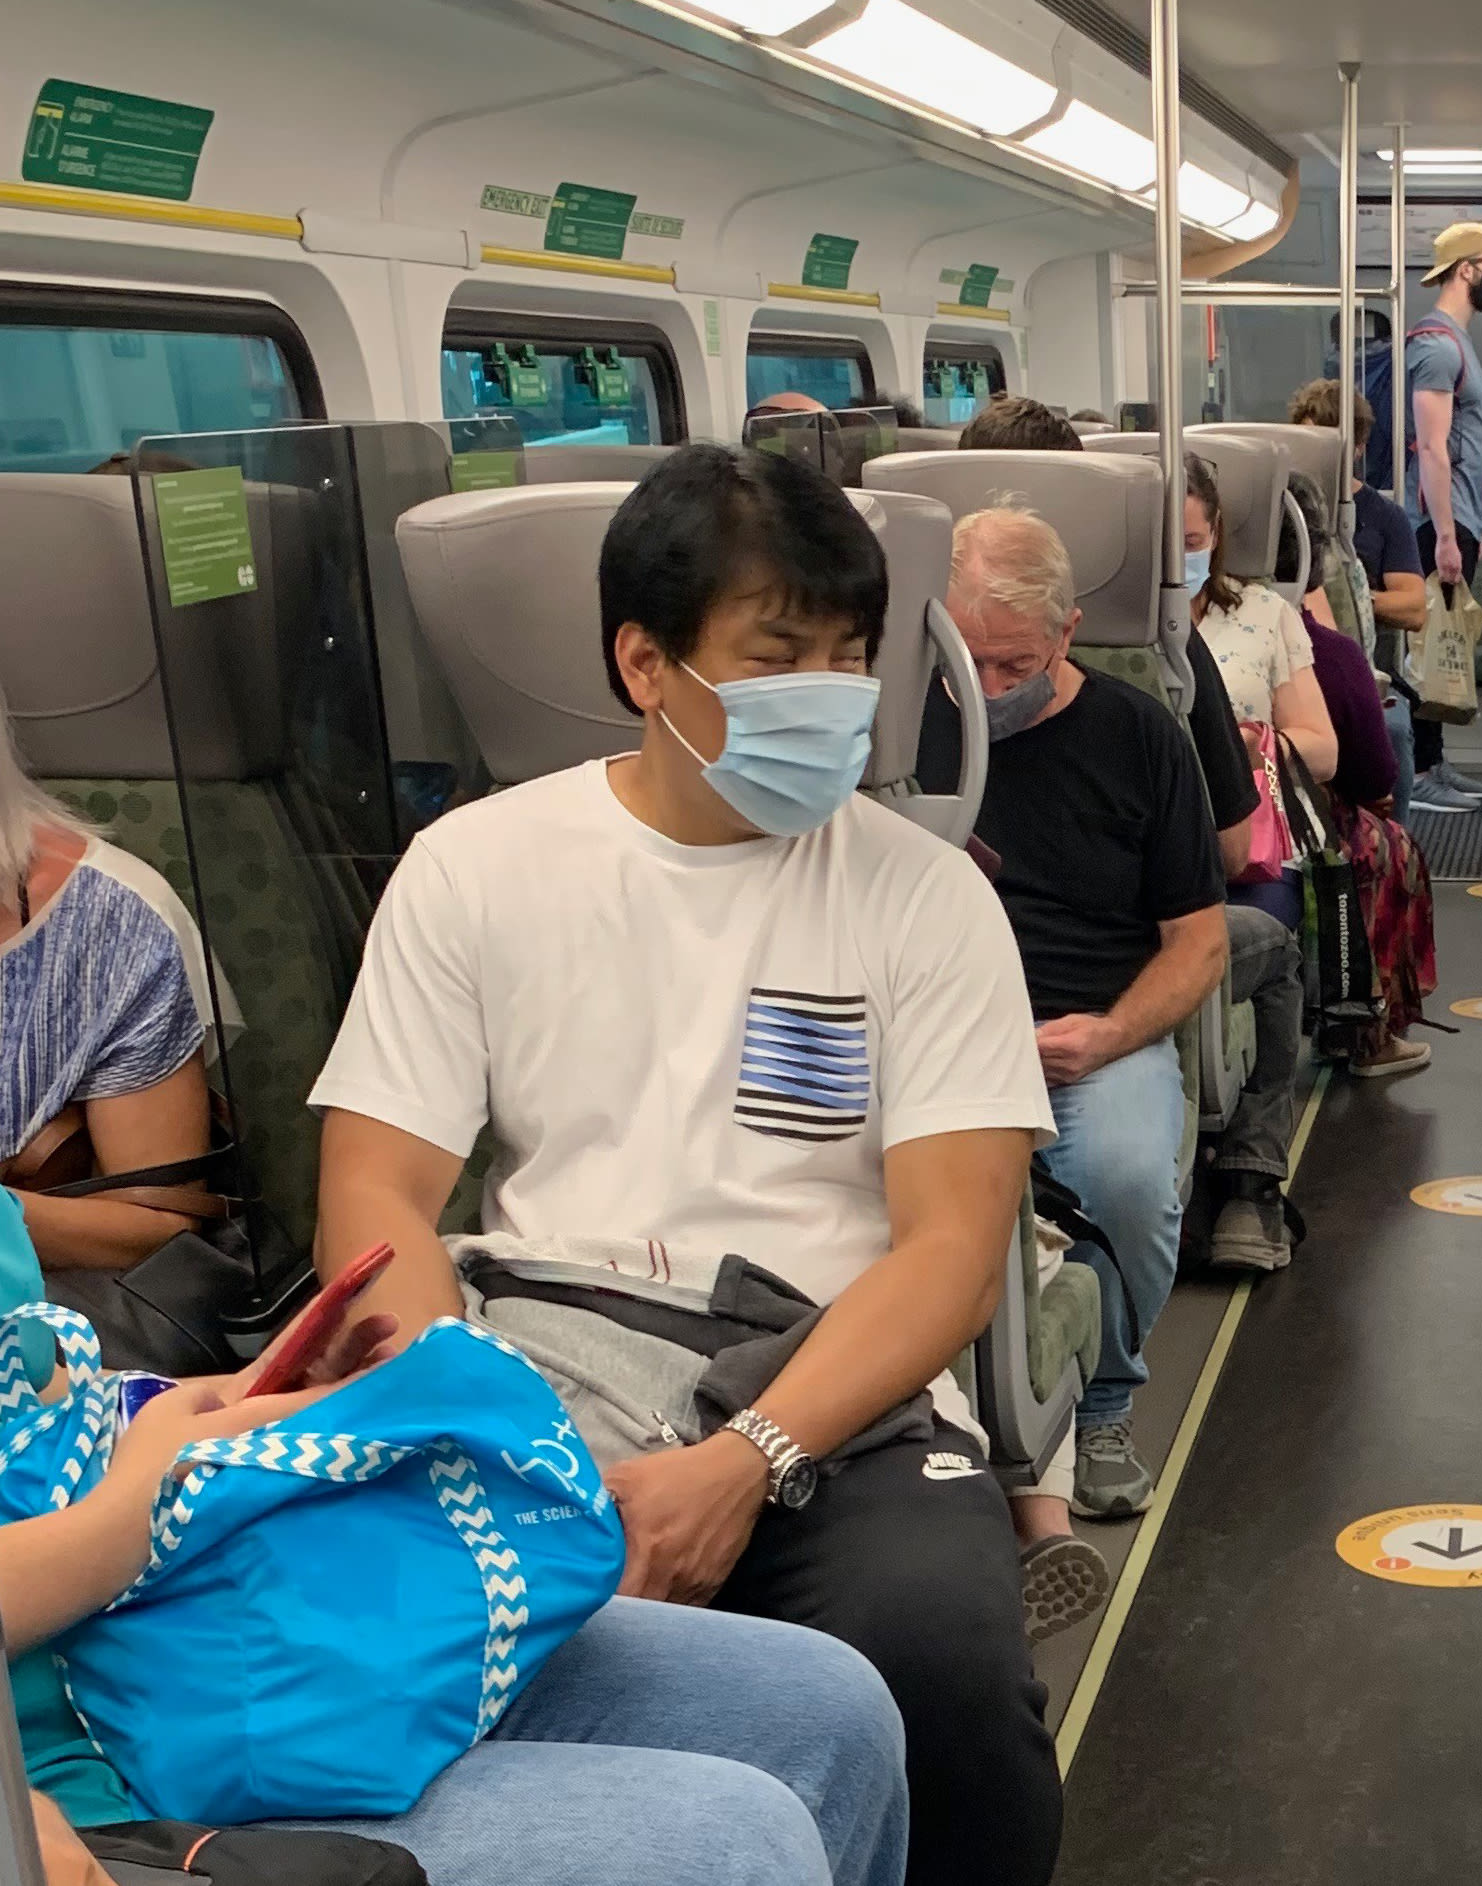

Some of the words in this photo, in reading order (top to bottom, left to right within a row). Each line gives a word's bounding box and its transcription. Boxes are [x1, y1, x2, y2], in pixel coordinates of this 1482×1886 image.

[484, 188, 530, 214] EMERGENCY
[1338, 892, 1350, 998] torontozoo.com
[926, 1452, 973, 1470] NIKE
[514, 1511, 540, 1526] THE
